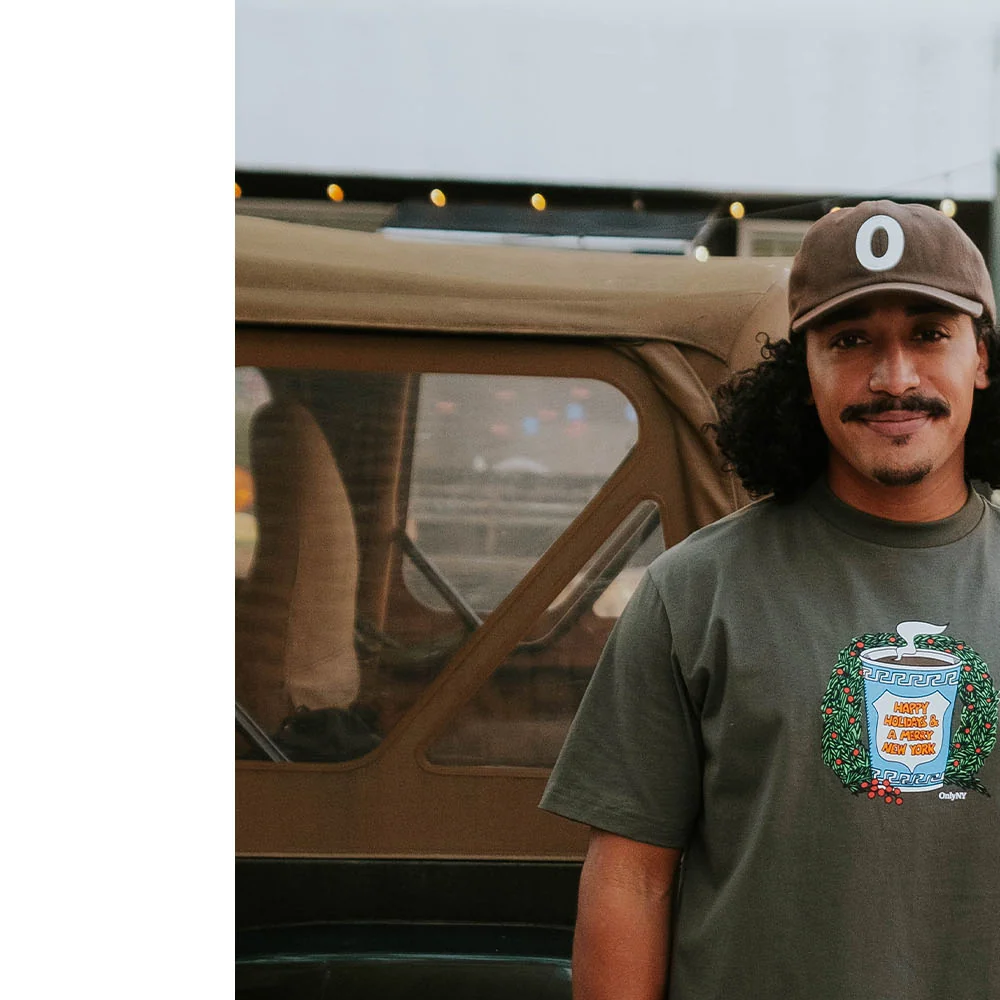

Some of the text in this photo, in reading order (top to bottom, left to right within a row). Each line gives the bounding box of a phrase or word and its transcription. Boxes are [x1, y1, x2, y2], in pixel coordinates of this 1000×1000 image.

[894, 701, 930, 714] HAPPY
[883, 714, 939, 728] HOLIDAYS &
[887, 729, 934, 741] A MERRY
[881, 742, 936, 756] NEW YORK
[938, 791, 967, 801] OnlyNY
